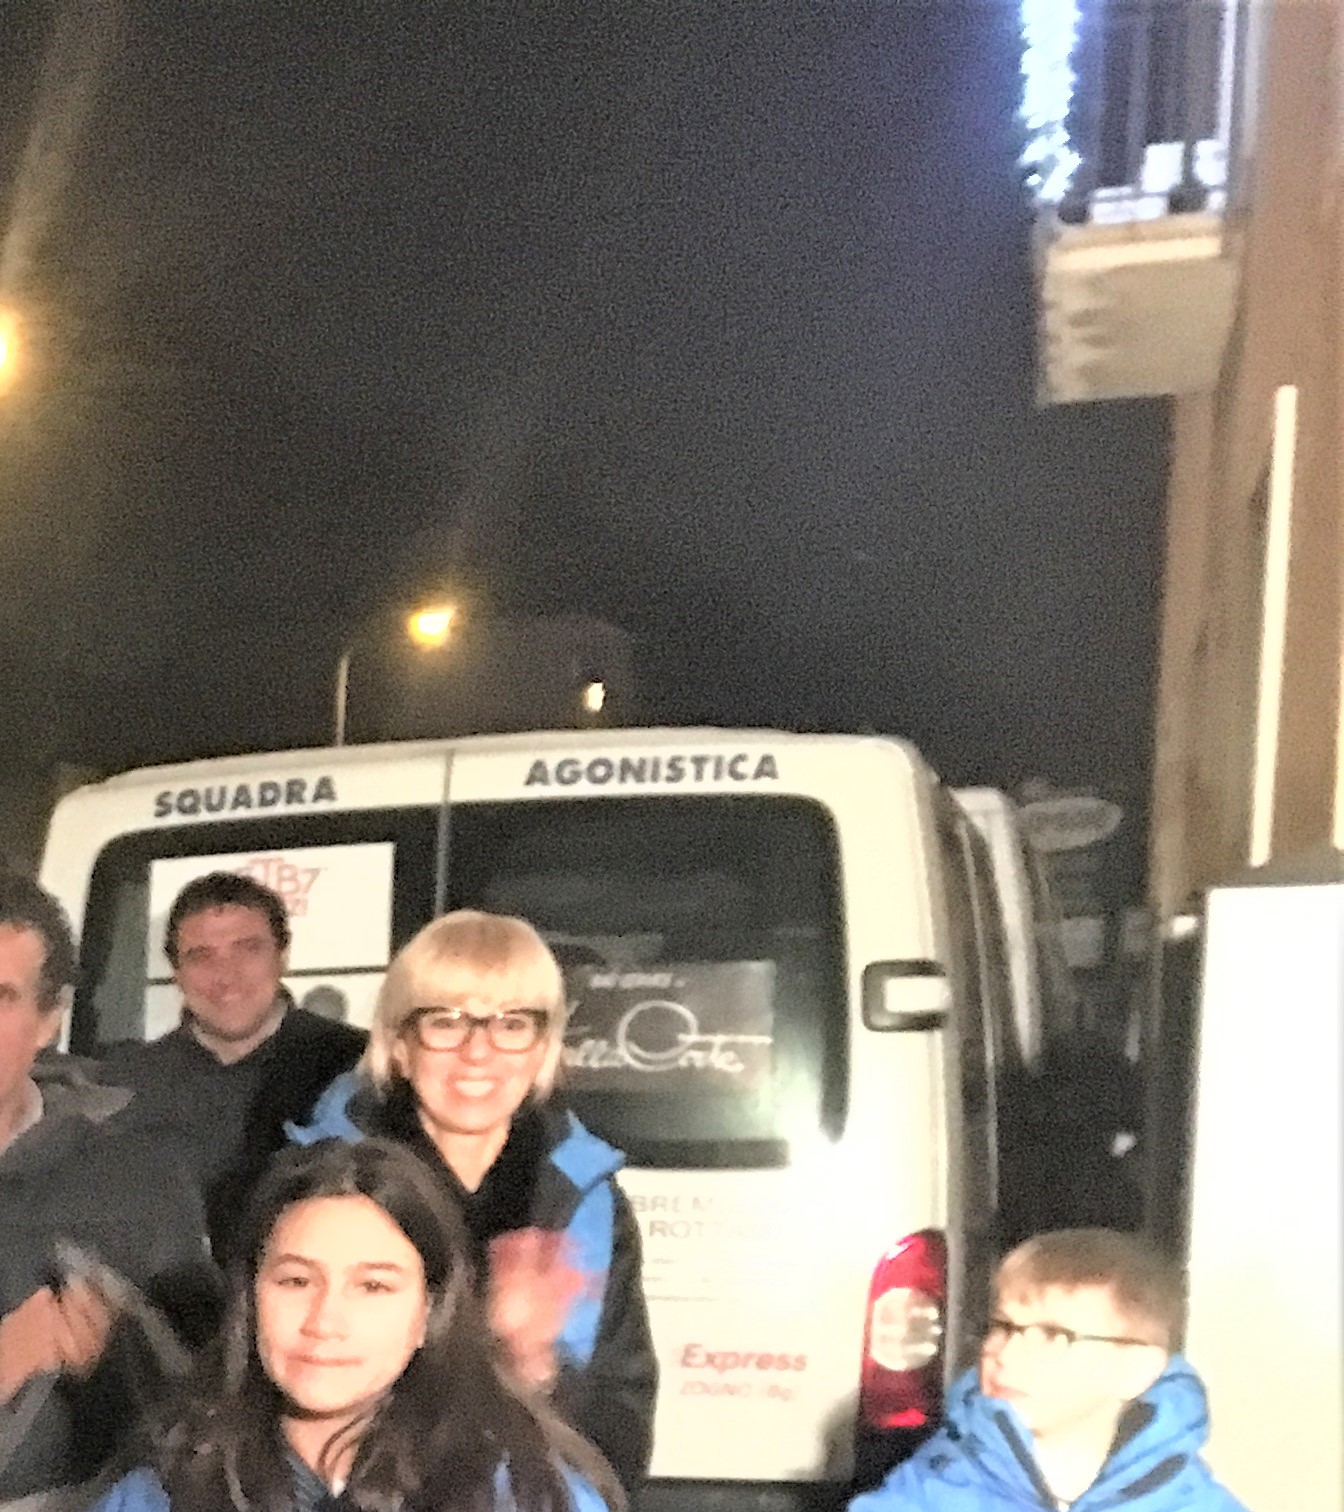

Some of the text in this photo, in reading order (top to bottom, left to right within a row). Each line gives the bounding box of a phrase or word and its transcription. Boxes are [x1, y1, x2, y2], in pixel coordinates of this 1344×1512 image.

[153, 752, 780, 818] SQUADRA AGONISTICA
[680, 1342, 809, 1375] Express
